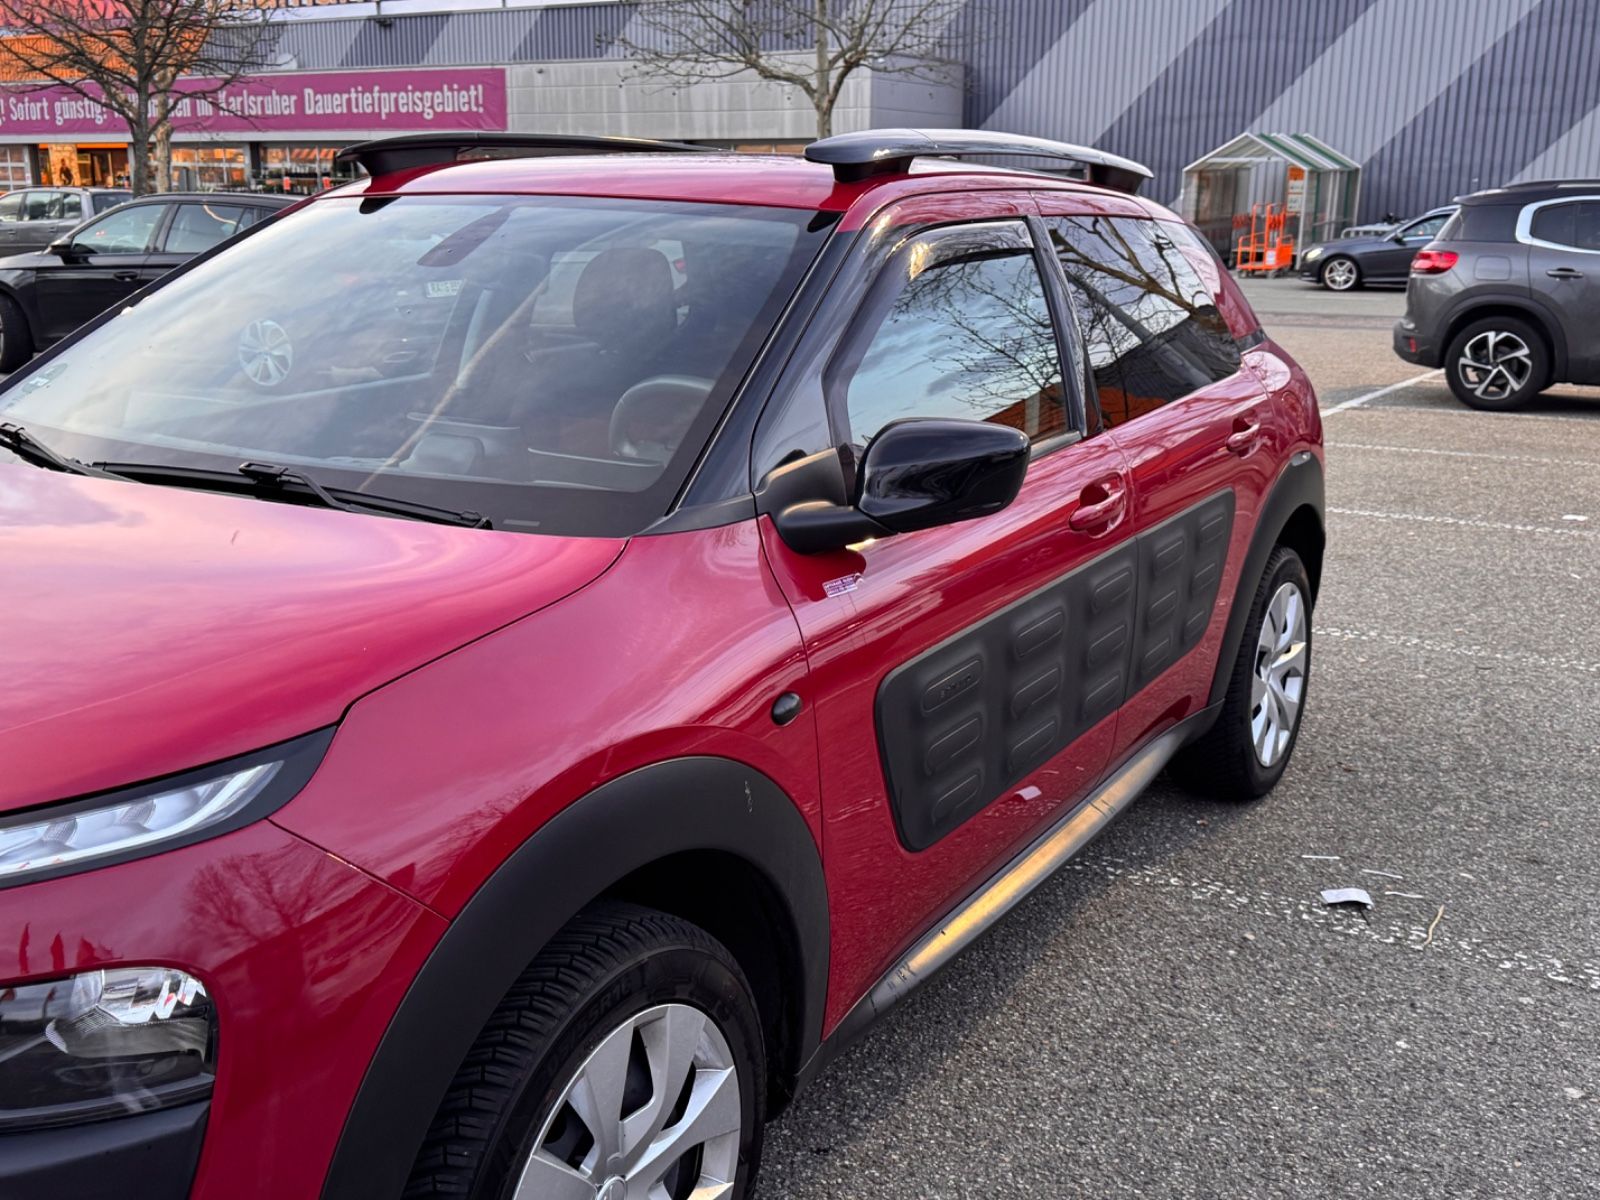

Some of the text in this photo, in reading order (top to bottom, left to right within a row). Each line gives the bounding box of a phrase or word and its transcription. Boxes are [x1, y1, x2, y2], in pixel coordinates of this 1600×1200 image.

[9, 96, 50, 120] Sofort
[54, 94, 107, 125] günstig!
[218, 88, 297, 117] Karlsruher
[304, 84, 484, 120] Dauertiefpreisgebiet!
